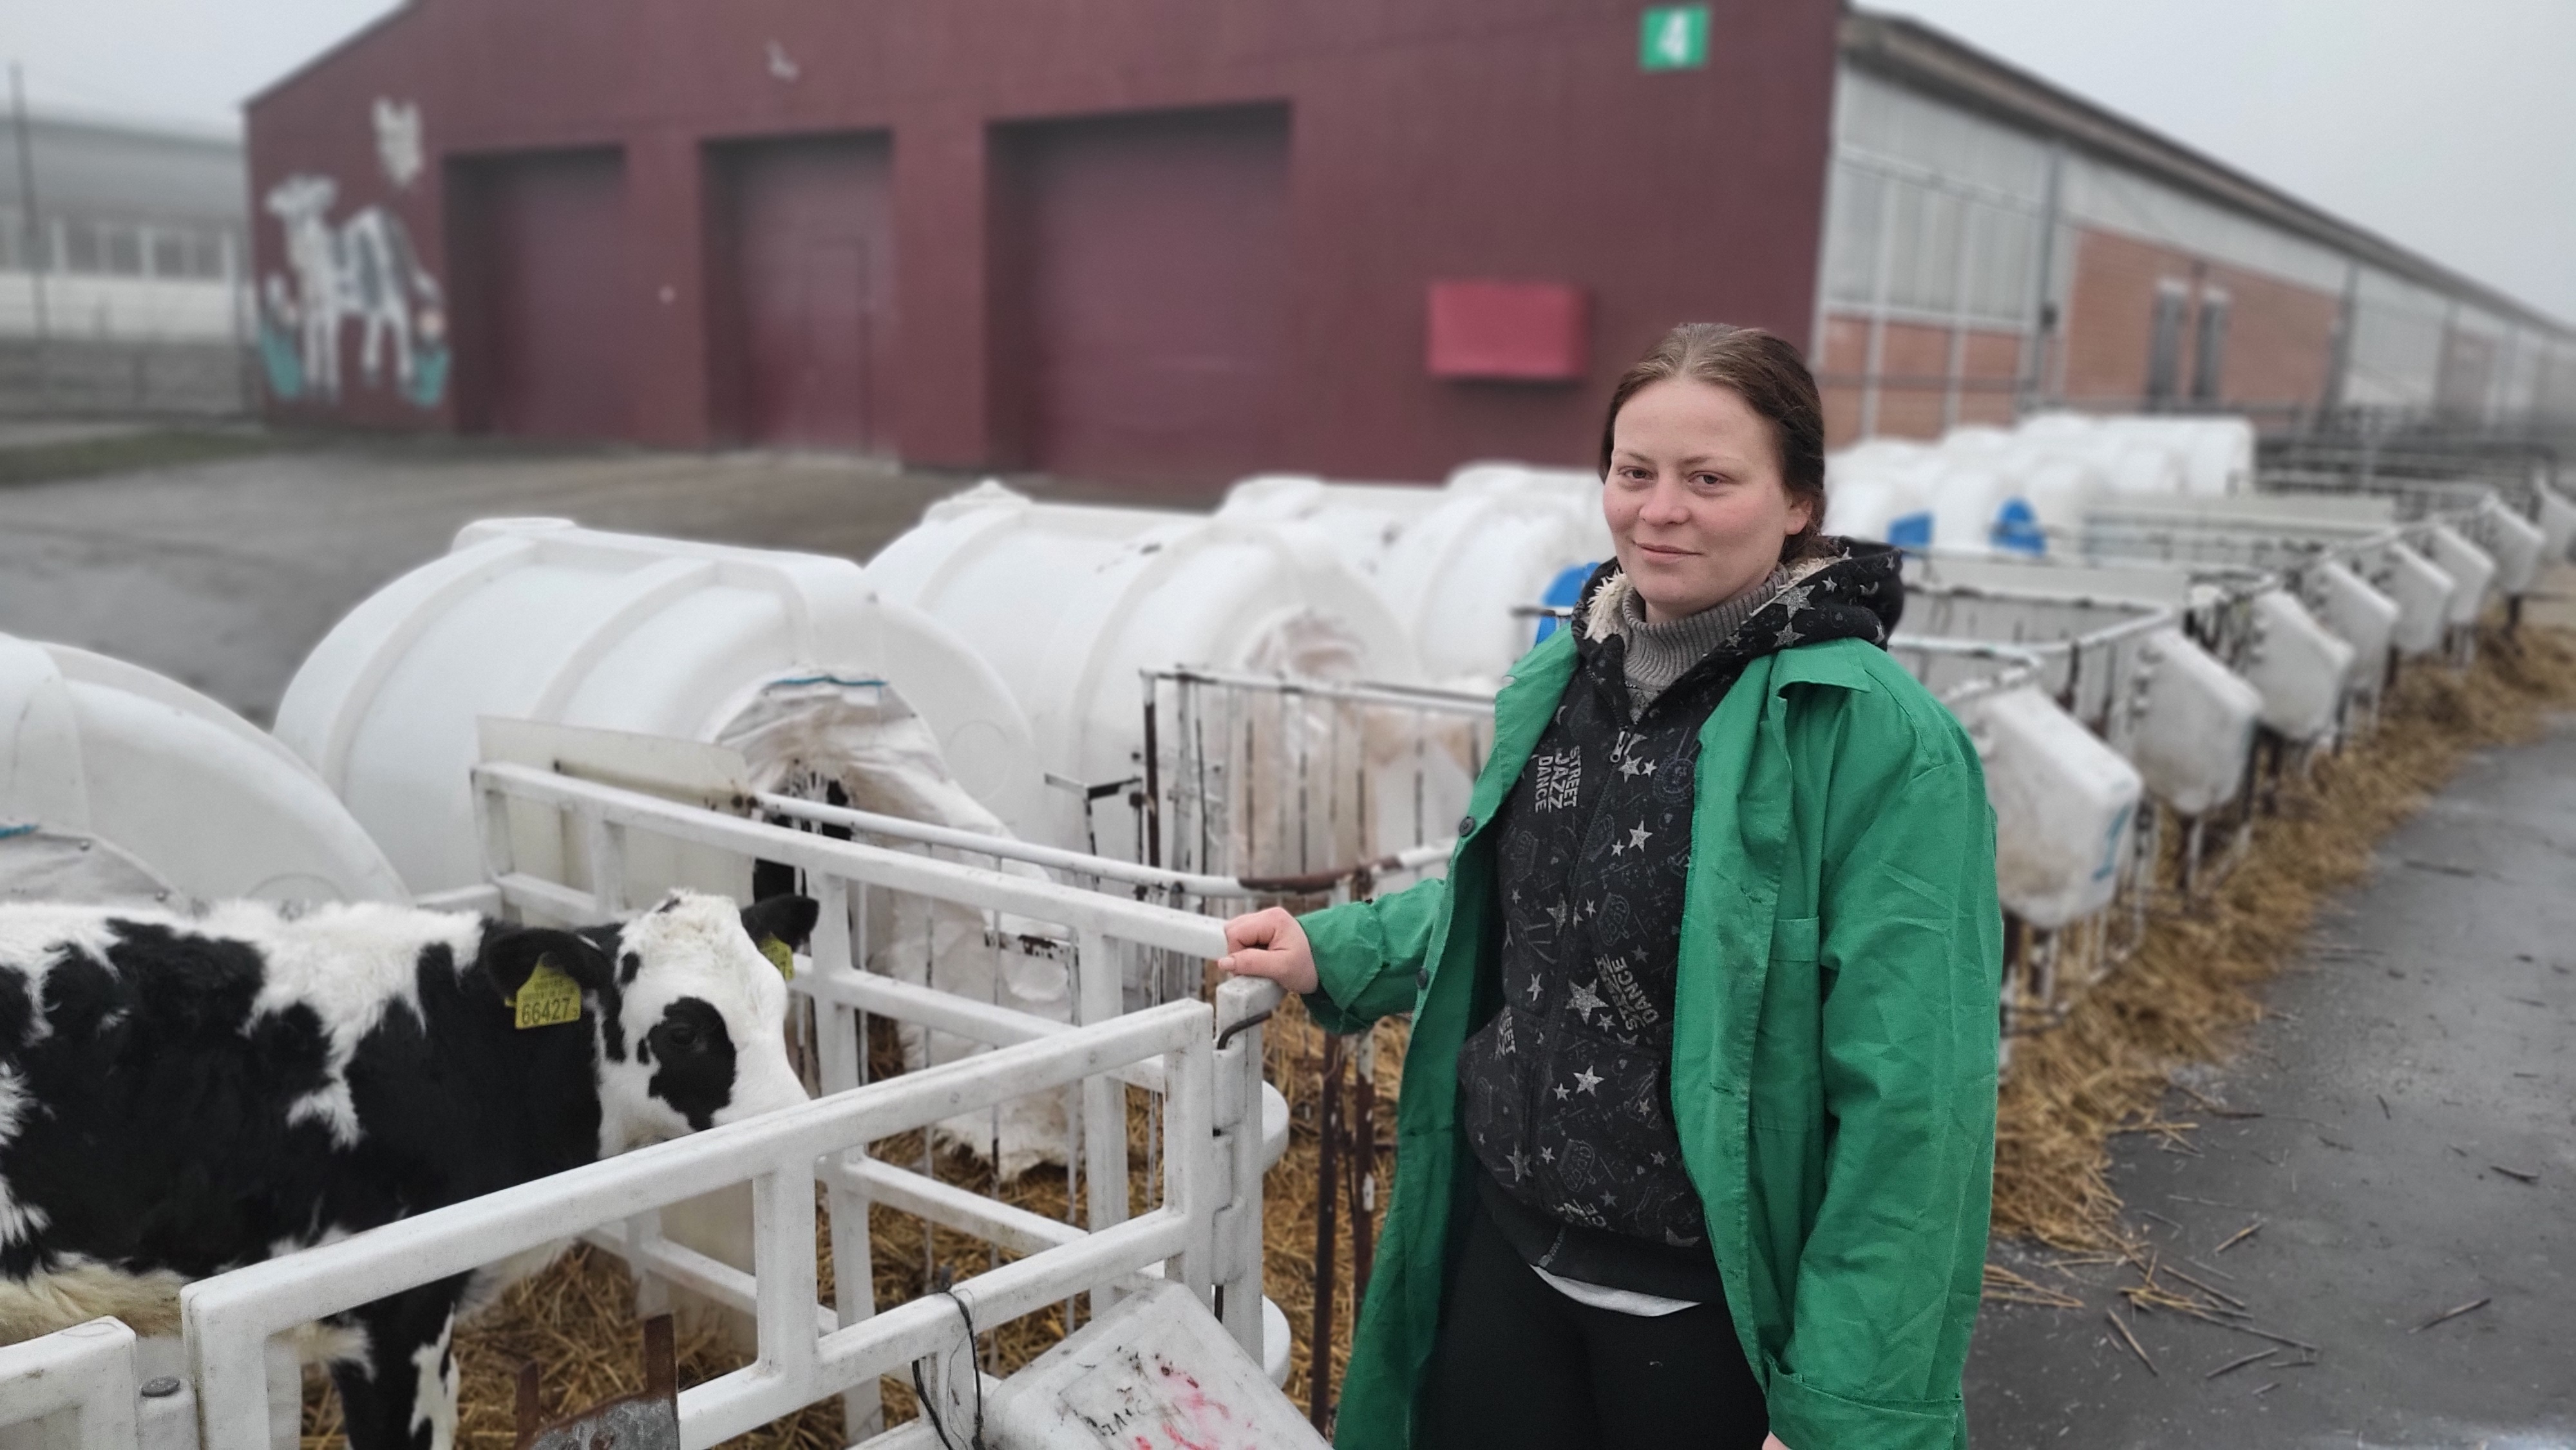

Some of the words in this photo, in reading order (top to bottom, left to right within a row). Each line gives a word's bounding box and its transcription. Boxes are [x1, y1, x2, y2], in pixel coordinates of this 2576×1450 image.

[1657, 11, 1689, 64] 4
[1535, 755, 1553, 813] DANCE
[1548, 748, 1569, 813] JAZZ
[1564, 746, 1581, 807] STREET
[522, 998, 571, 1024] 66427
[1611, 957, 1660, 1024] DANCE
